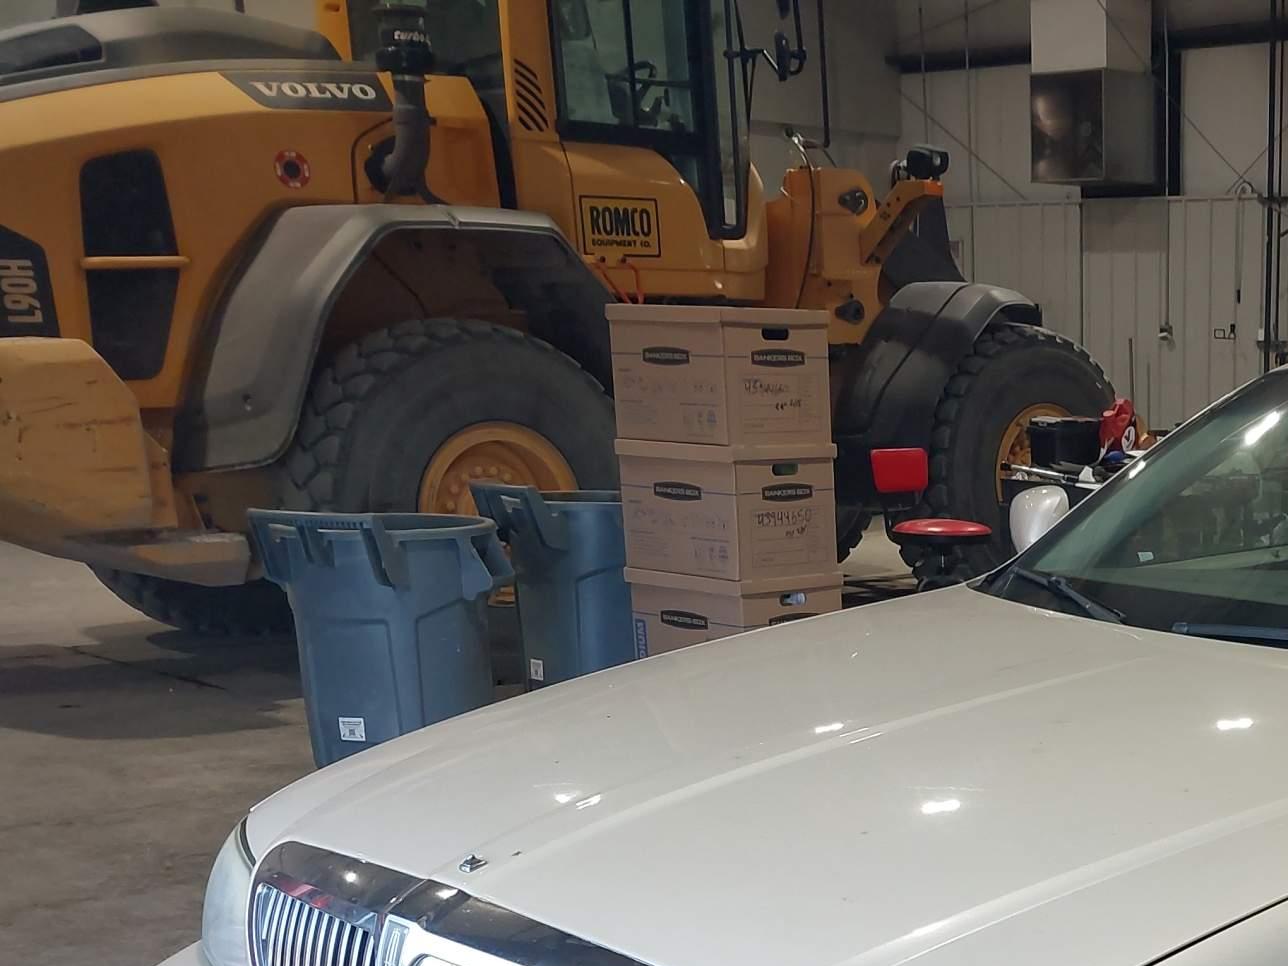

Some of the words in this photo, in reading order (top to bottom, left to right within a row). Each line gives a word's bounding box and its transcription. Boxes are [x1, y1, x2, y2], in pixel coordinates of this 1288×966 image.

[250, 81, 376, 100] VOLVO
[589, 206, 652, 237] ROMCO
[591, 239, 636, 248] EQUIPMENT
[0, 259, 43, 322] L90H
[655, 486, 685, 495] BANKERS
[764, 488, 796, 497] BANKERS
[796, 487, 811, 495] BOX
[663, 614, 692, 624] BANKERS
